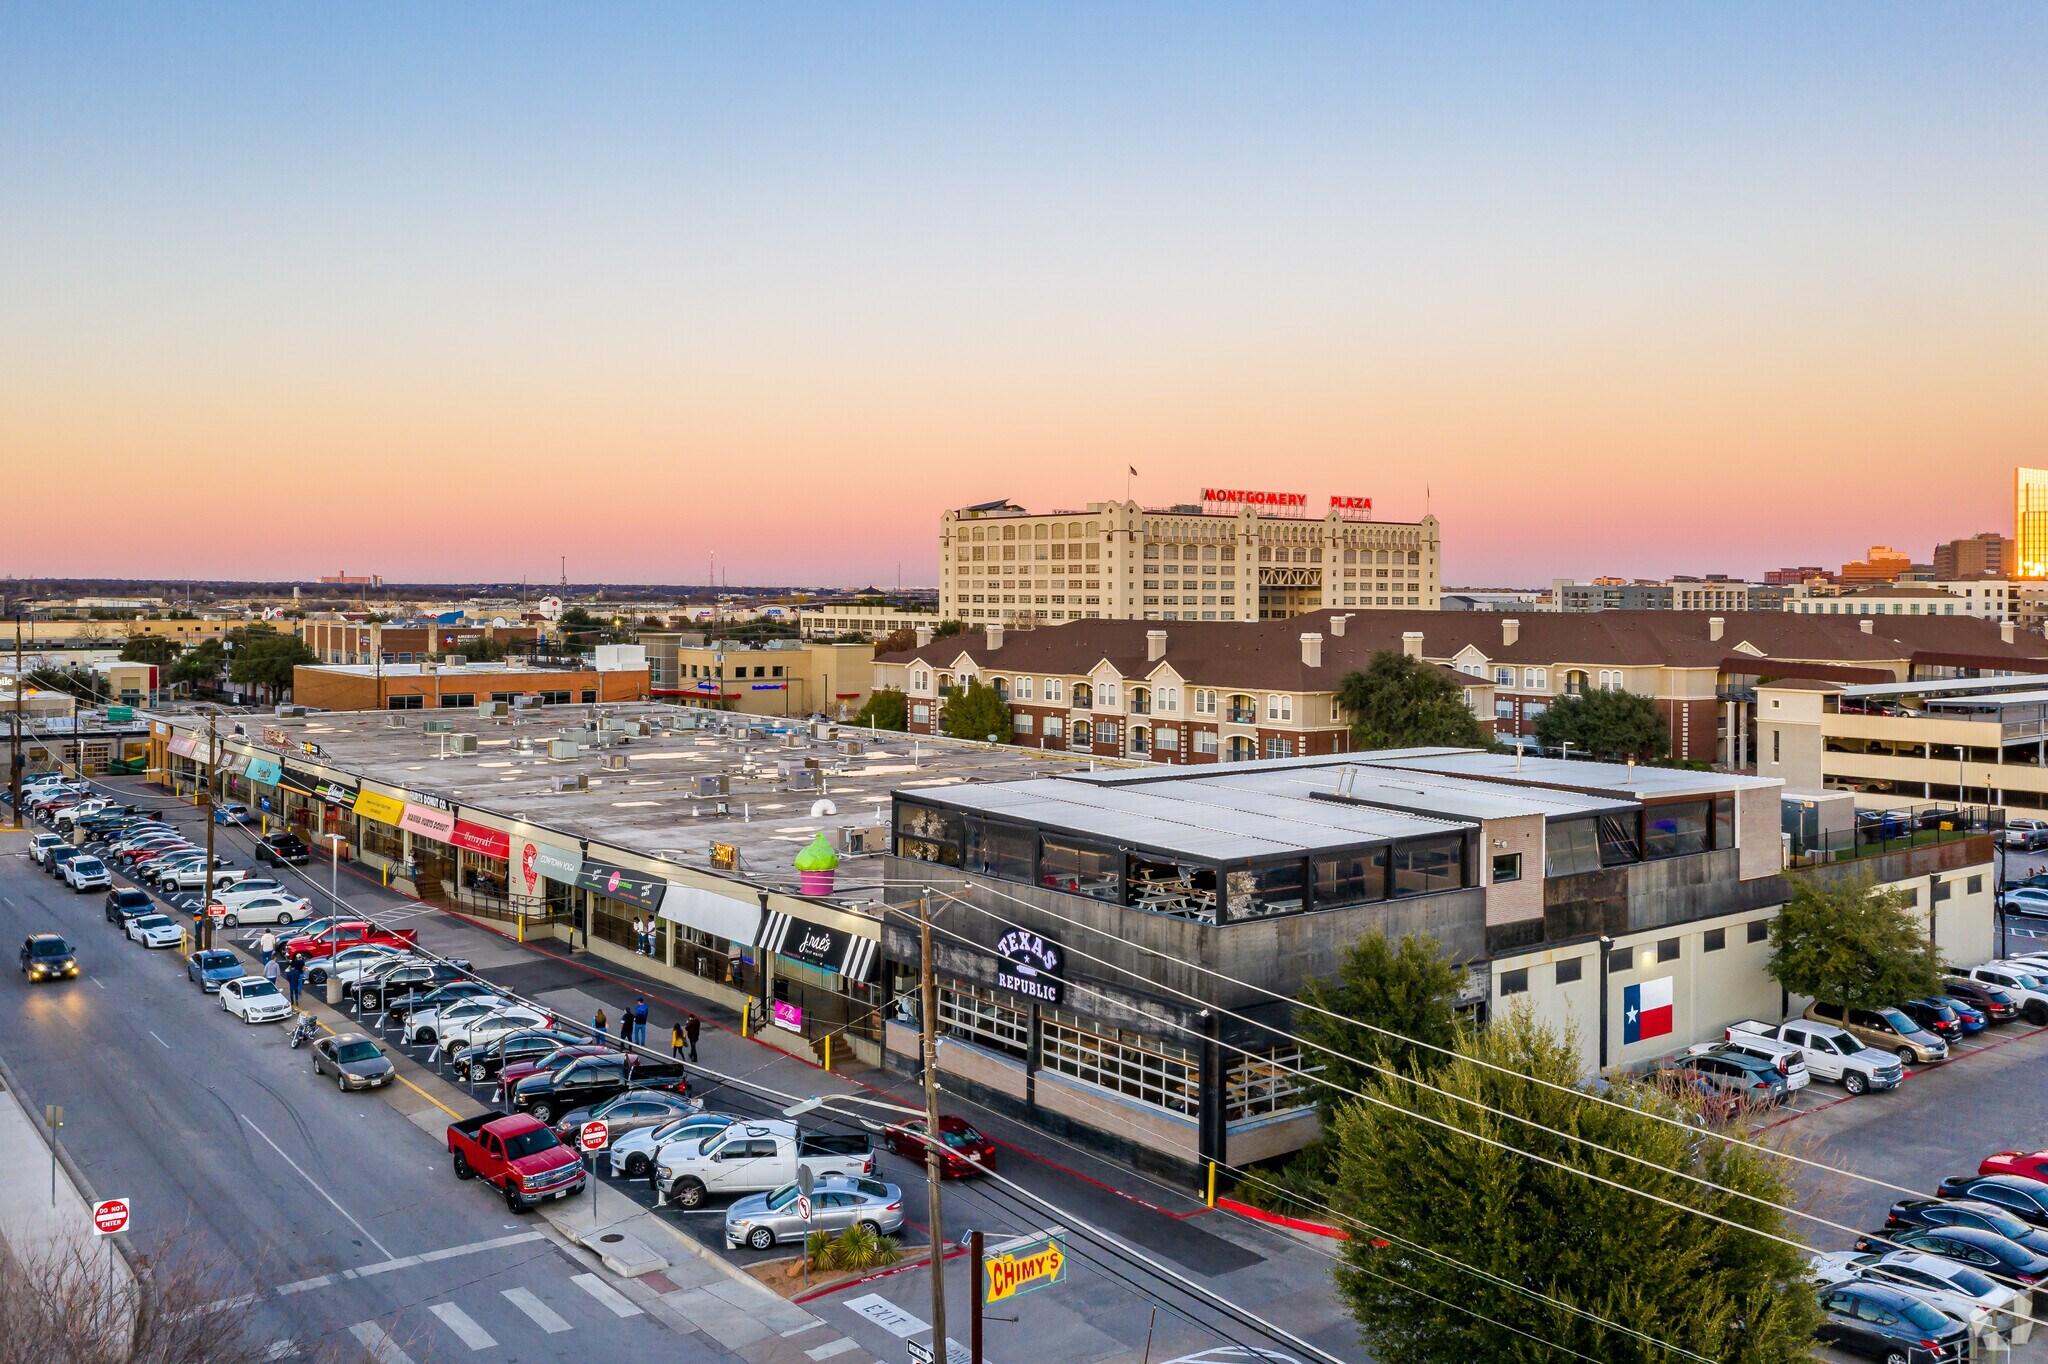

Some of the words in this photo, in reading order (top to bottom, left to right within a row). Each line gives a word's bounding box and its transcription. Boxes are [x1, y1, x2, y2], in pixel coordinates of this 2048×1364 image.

[1204, 489, 1306, 506] MONTGOMERY
[1331, 496, 1372, 509] PLAZA
[0, 676, 13, 686] ile
[409, 790, 424, 803] HURTS
[423, 794, 439, 807] DONUT
[540, 854, 562, 870] COWTOWN
[561, 861, 575, 872] YOGA
[997, 931, 1058, 970] TEXAS
[998, 972, 1056, 1001] REPUBLIC
[587, 1137, 602, 1145] ENTER
[111, 1205, 124, 1213] NOT
[101, 1219, 122, 1228] ENTER
[993, 1252, 1059, 1296] CHIMY'S
[862, 1303, 906, 1326] EXIT
